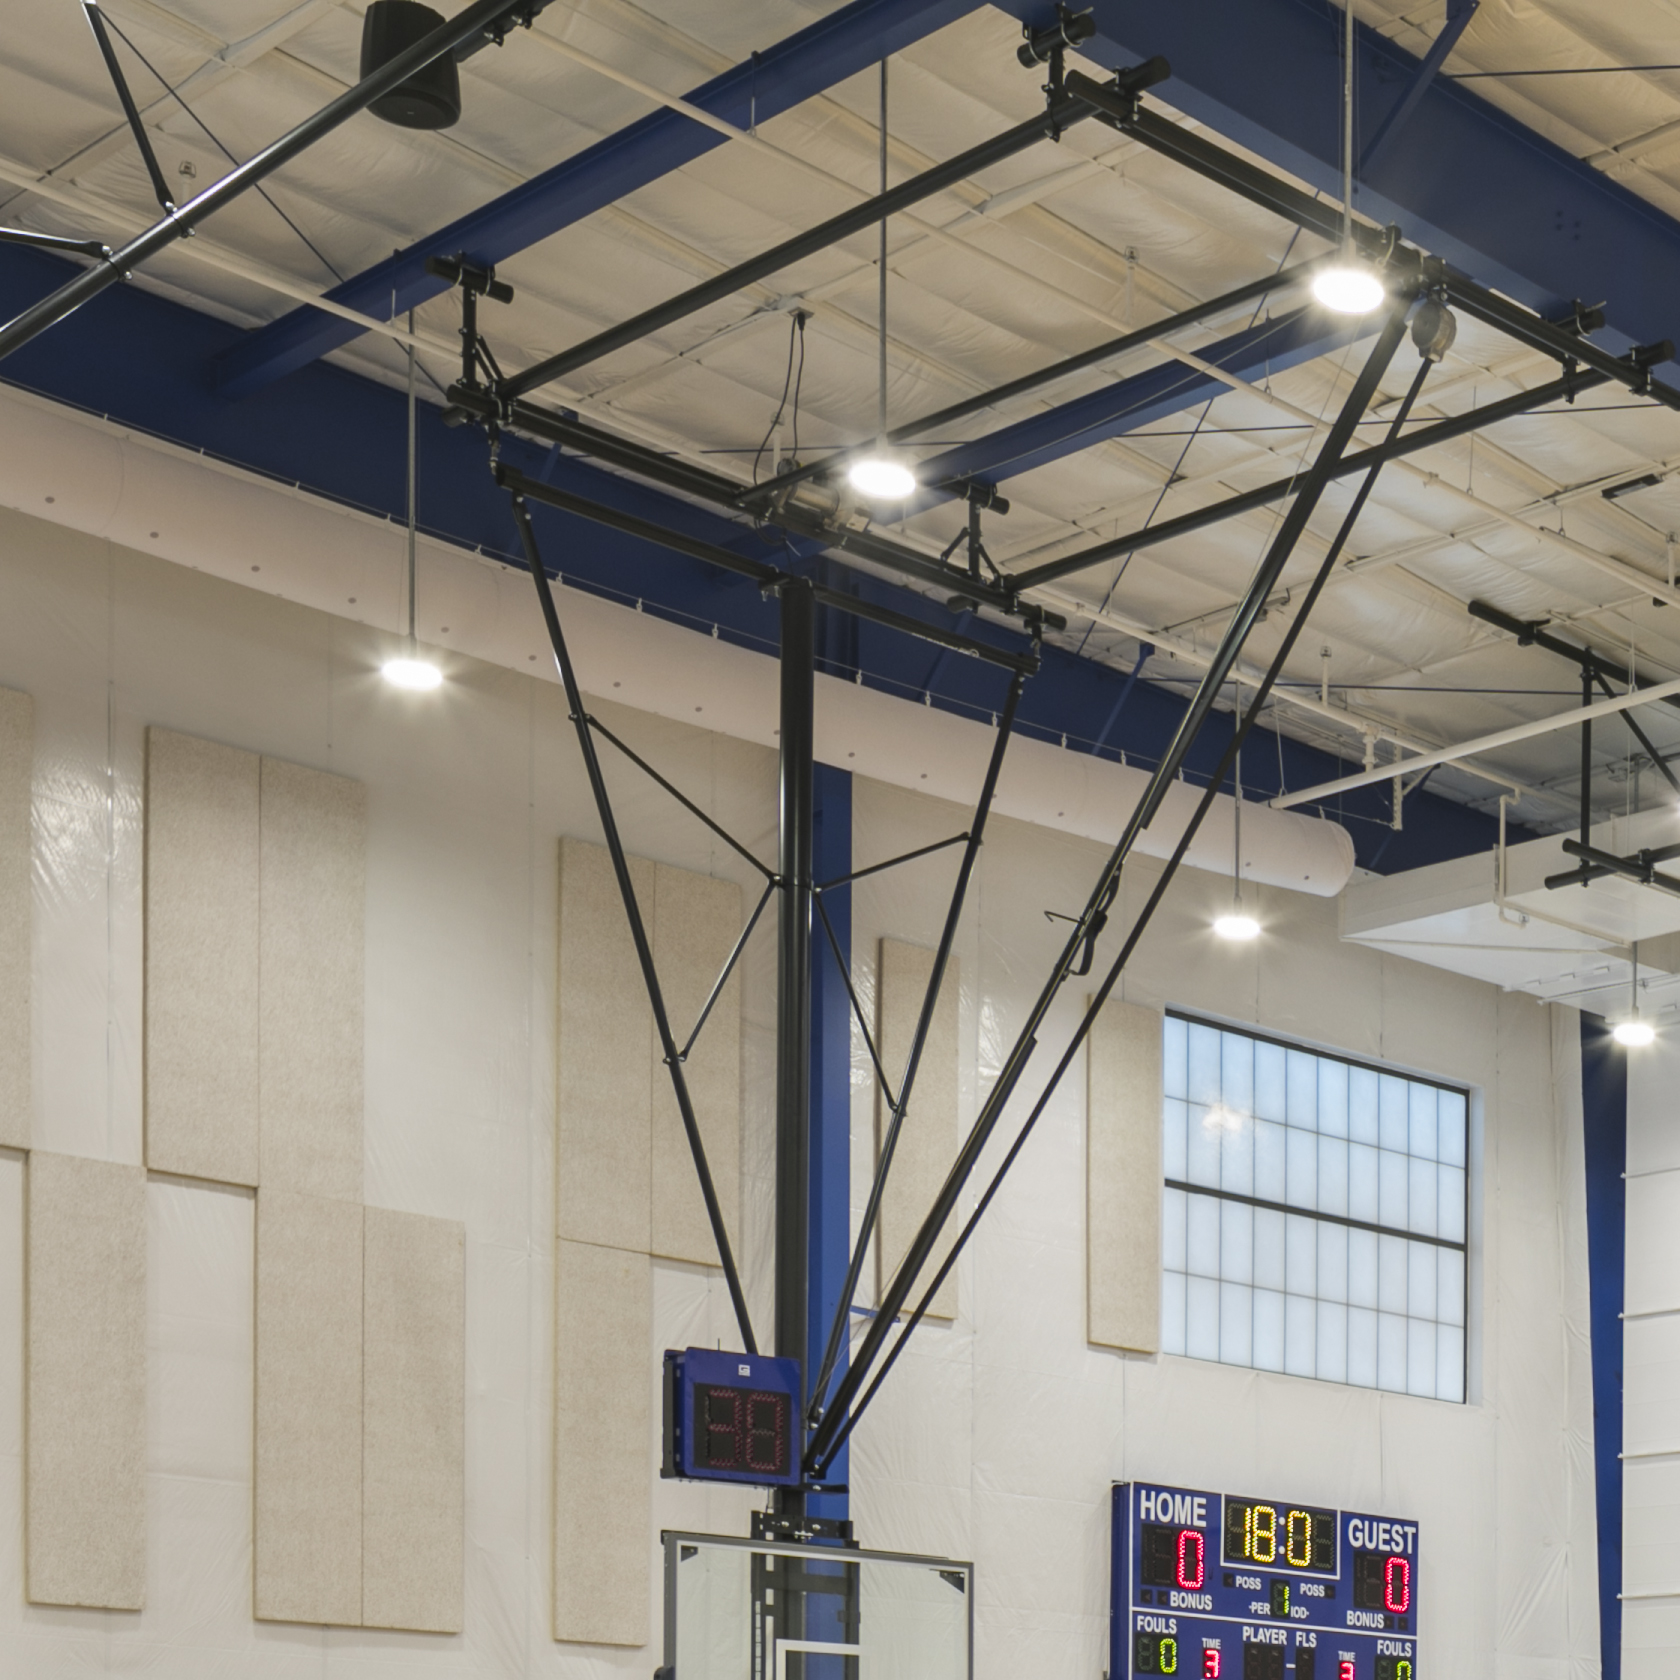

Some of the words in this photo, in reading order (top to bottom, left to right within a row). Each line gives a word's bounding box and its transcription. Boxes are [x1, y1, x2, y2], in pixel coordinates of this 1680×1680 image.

[1140, 1489, 1207, 1528] HOME
[1348, 1518, 1416, 1555] GUEST
[1177, 1529, 1205, 1590] 0
[1235, 1575, 1262, 1591] POSS
[1300, 1582, 1325, 1598] POSS
[1384, 1555, 1411, 1614] 0
[1170, 1591, 1213, 1611] BONUS
[1282, 1585, 1290, 1615] 1
[1137, 1615, 1177, 1634] FOULS
[1346, 1610, 1385, 1629] BONUS
[1201, 1638, 1221, 1650] TIME
[1242, 1626, 1287, 1646] PLAYER
[1296, 1631, 1317, 1649] FLS
[1377, 1639, 1413, 1657] FOULS
[1159, 1638, 1178, 1674] 0
[1204, 1649, 1220, 1679] 3
[1338, 1650, 1356, 1662] TIME
